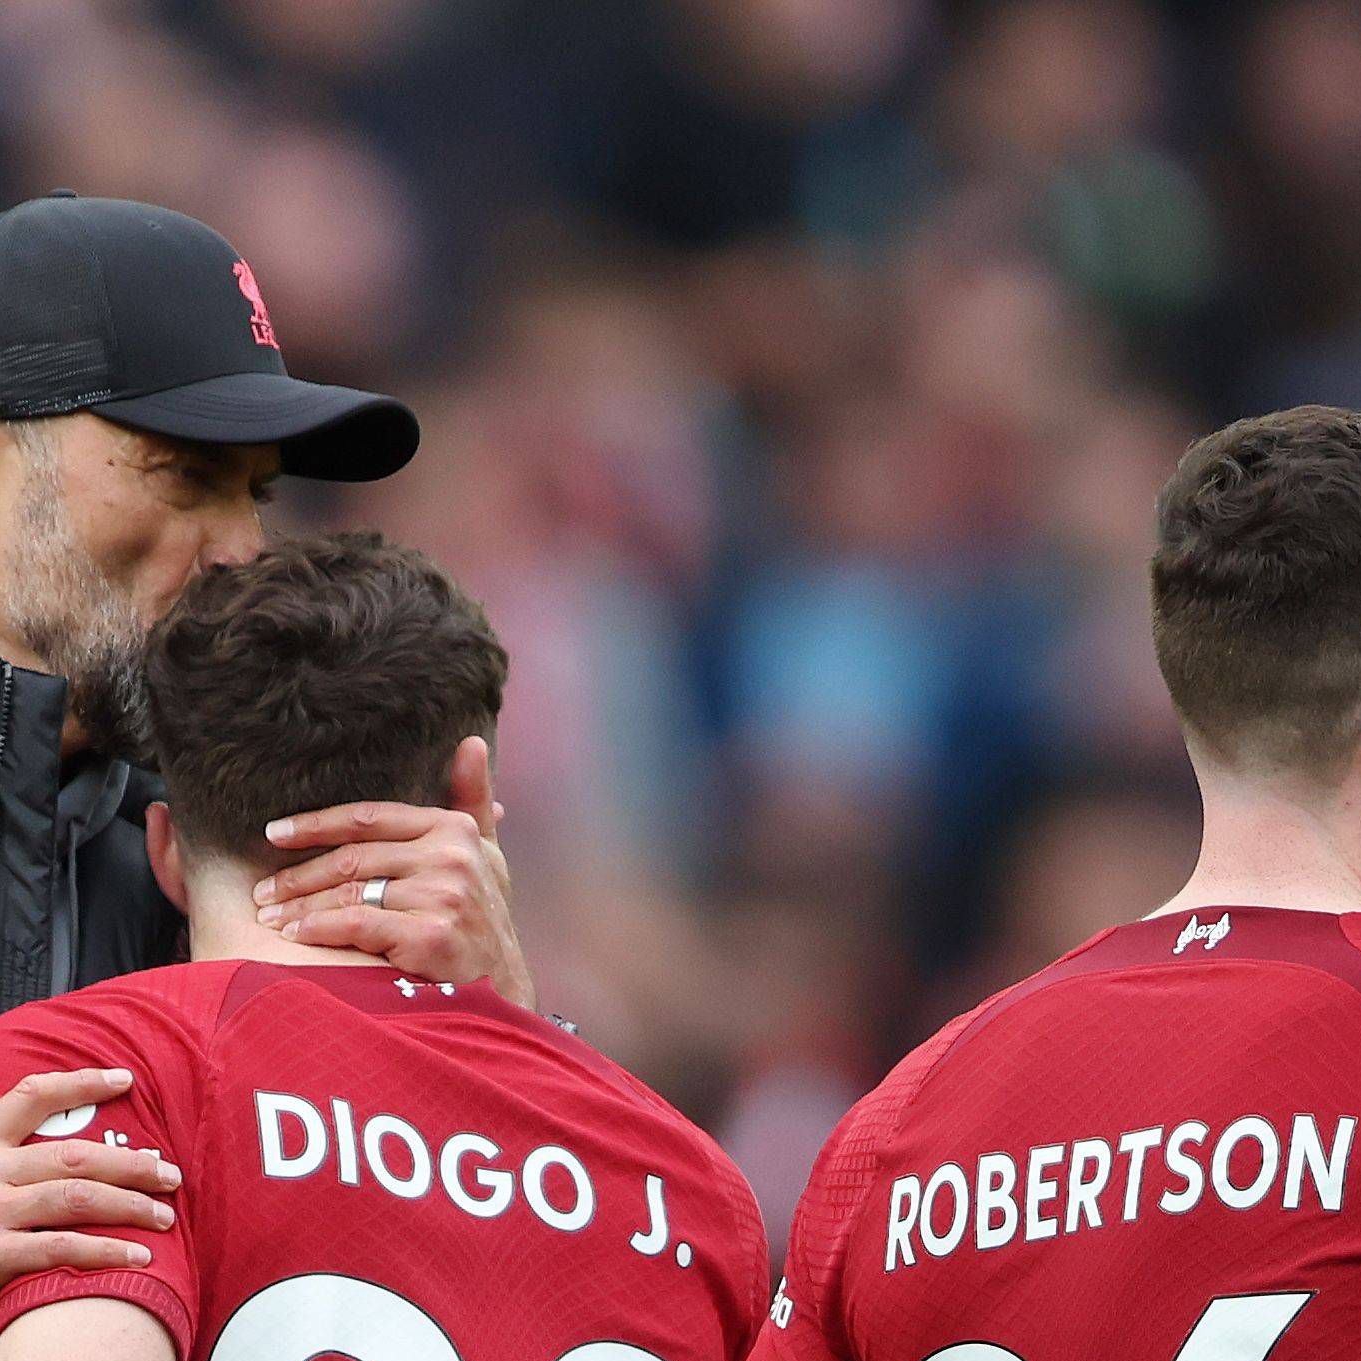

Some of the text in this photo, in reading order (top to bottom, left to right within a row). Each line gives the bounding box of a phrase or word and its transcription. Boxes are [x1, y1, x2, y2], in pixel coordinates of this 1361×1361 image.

[254, 1089, 693, 1269] DIOGO J.
[884, 1113, 1358, 1273] ROBERTSON
